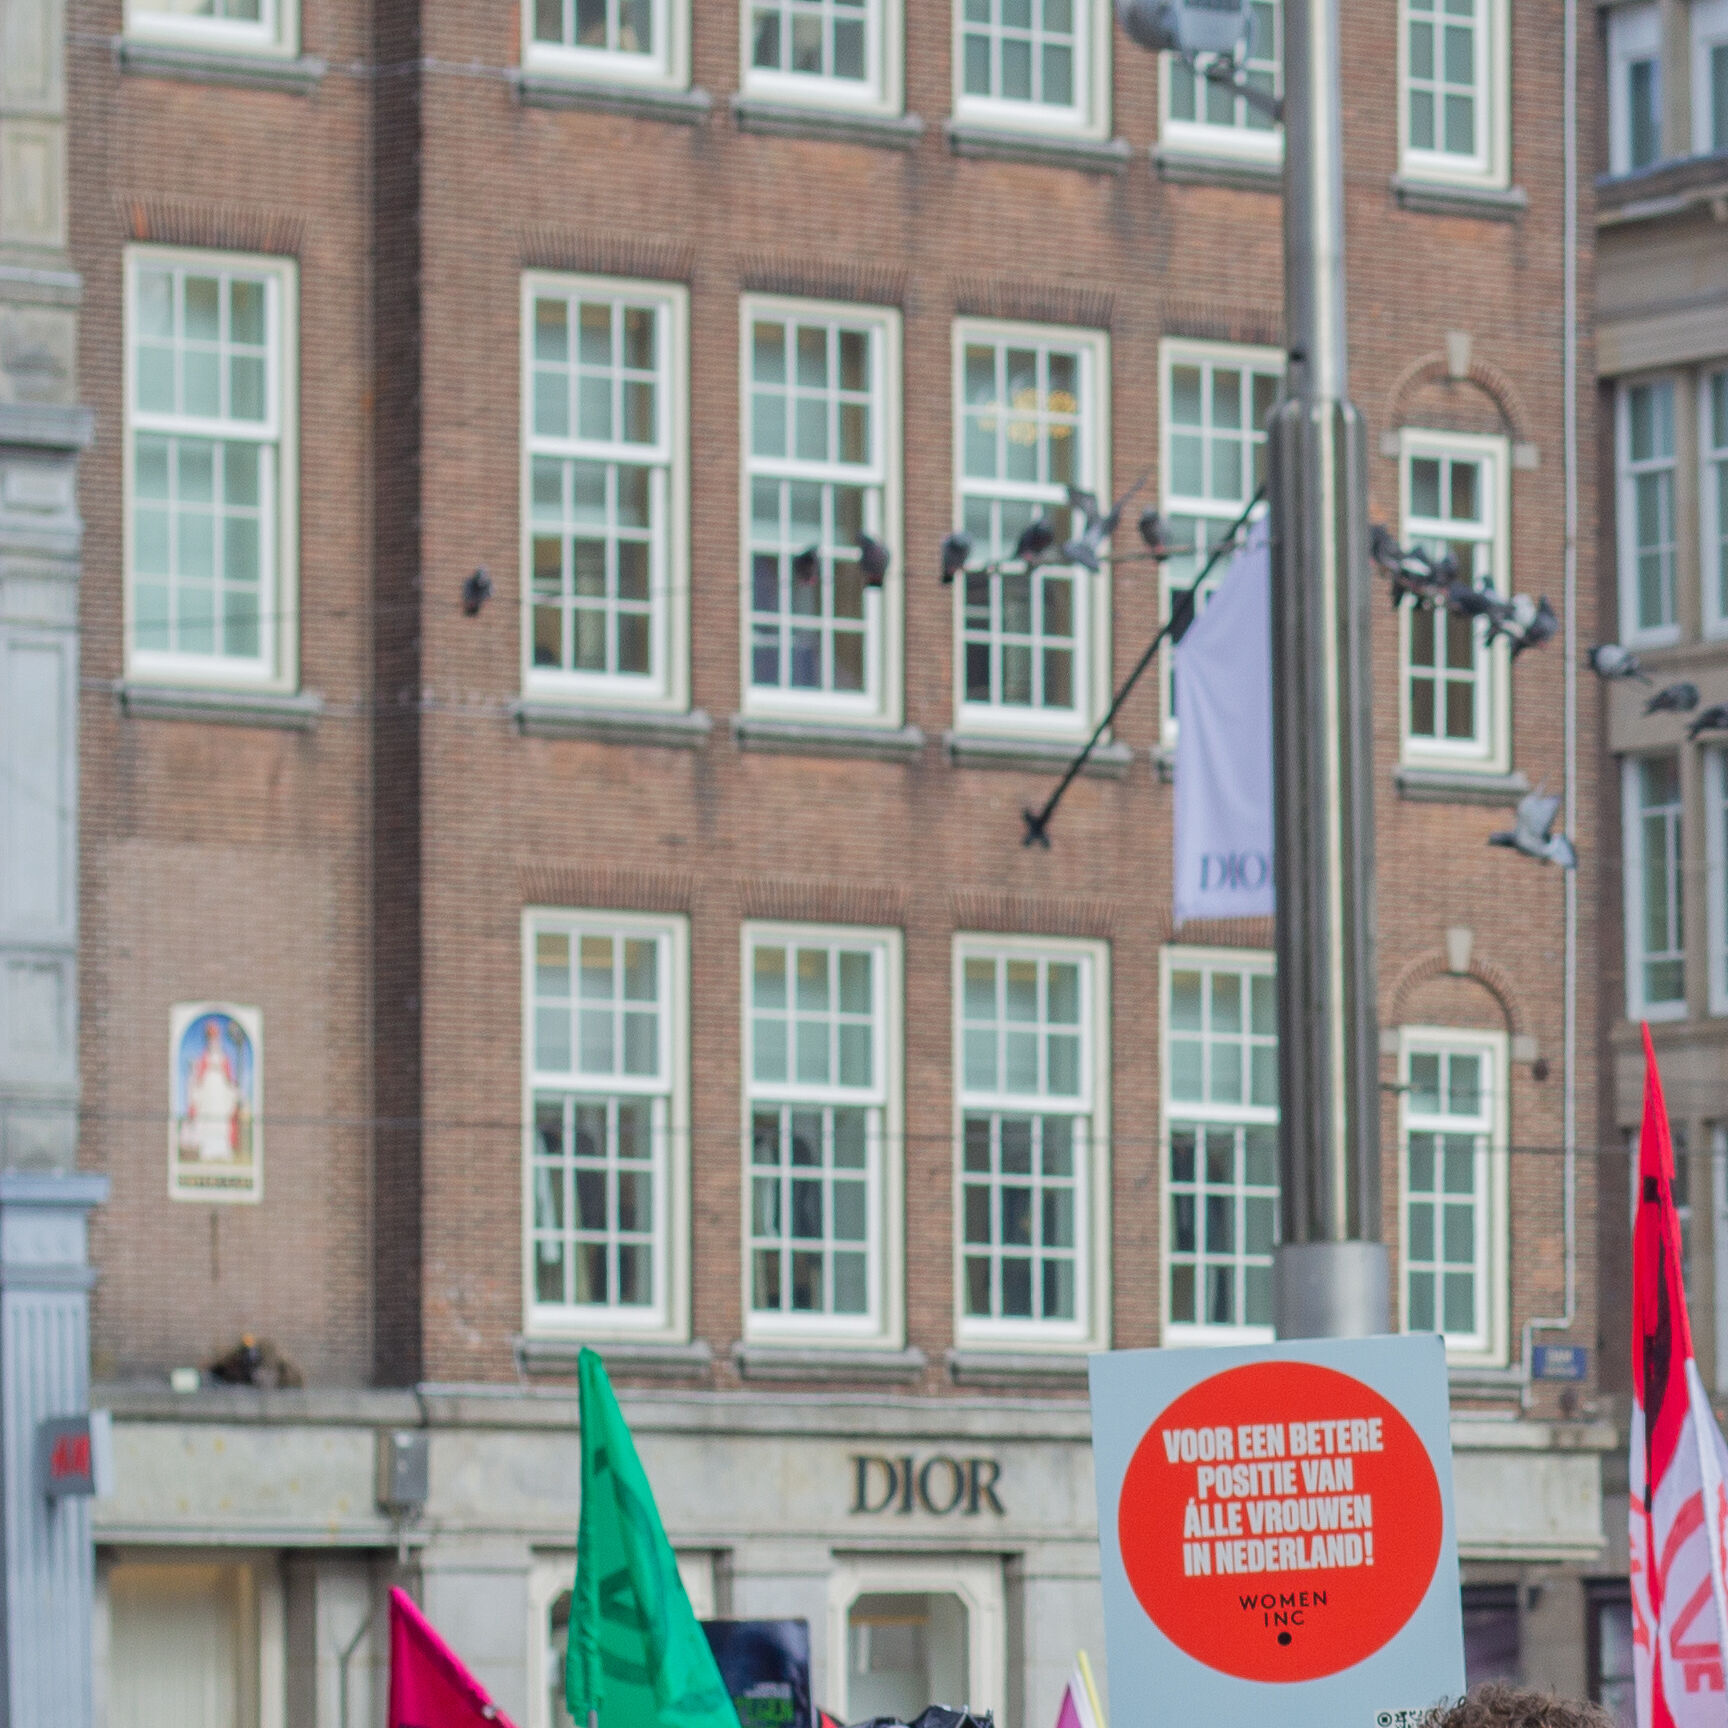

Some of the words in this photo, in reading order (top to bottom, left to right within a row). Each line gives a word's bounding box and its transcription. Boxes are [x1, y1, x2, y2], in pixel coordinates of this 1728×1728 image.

[1200, 851, 1274, 891] DIO
[1162, 1427, 1235, 1464] VOOR
[1237, 1424, 1285, 1460] EEN
[1288, 1418, 1384, 1456] BETERE
[847, 1454, 1006, 1516] DIOR
[1197, 1460, 1298, 1500] POSITIE
[1301, 1457, 1354, 1493] VAN
[1245, 1494, 1373, 1535] VROUWEN
[1183, 1542, 1212, 1577] IN
[1215, 1532, 1374, 1575] NEDERLAND!
[1239, 1591, 1328, 1611] WOMEN
[1264, 1611, 1305, 1628] INC
